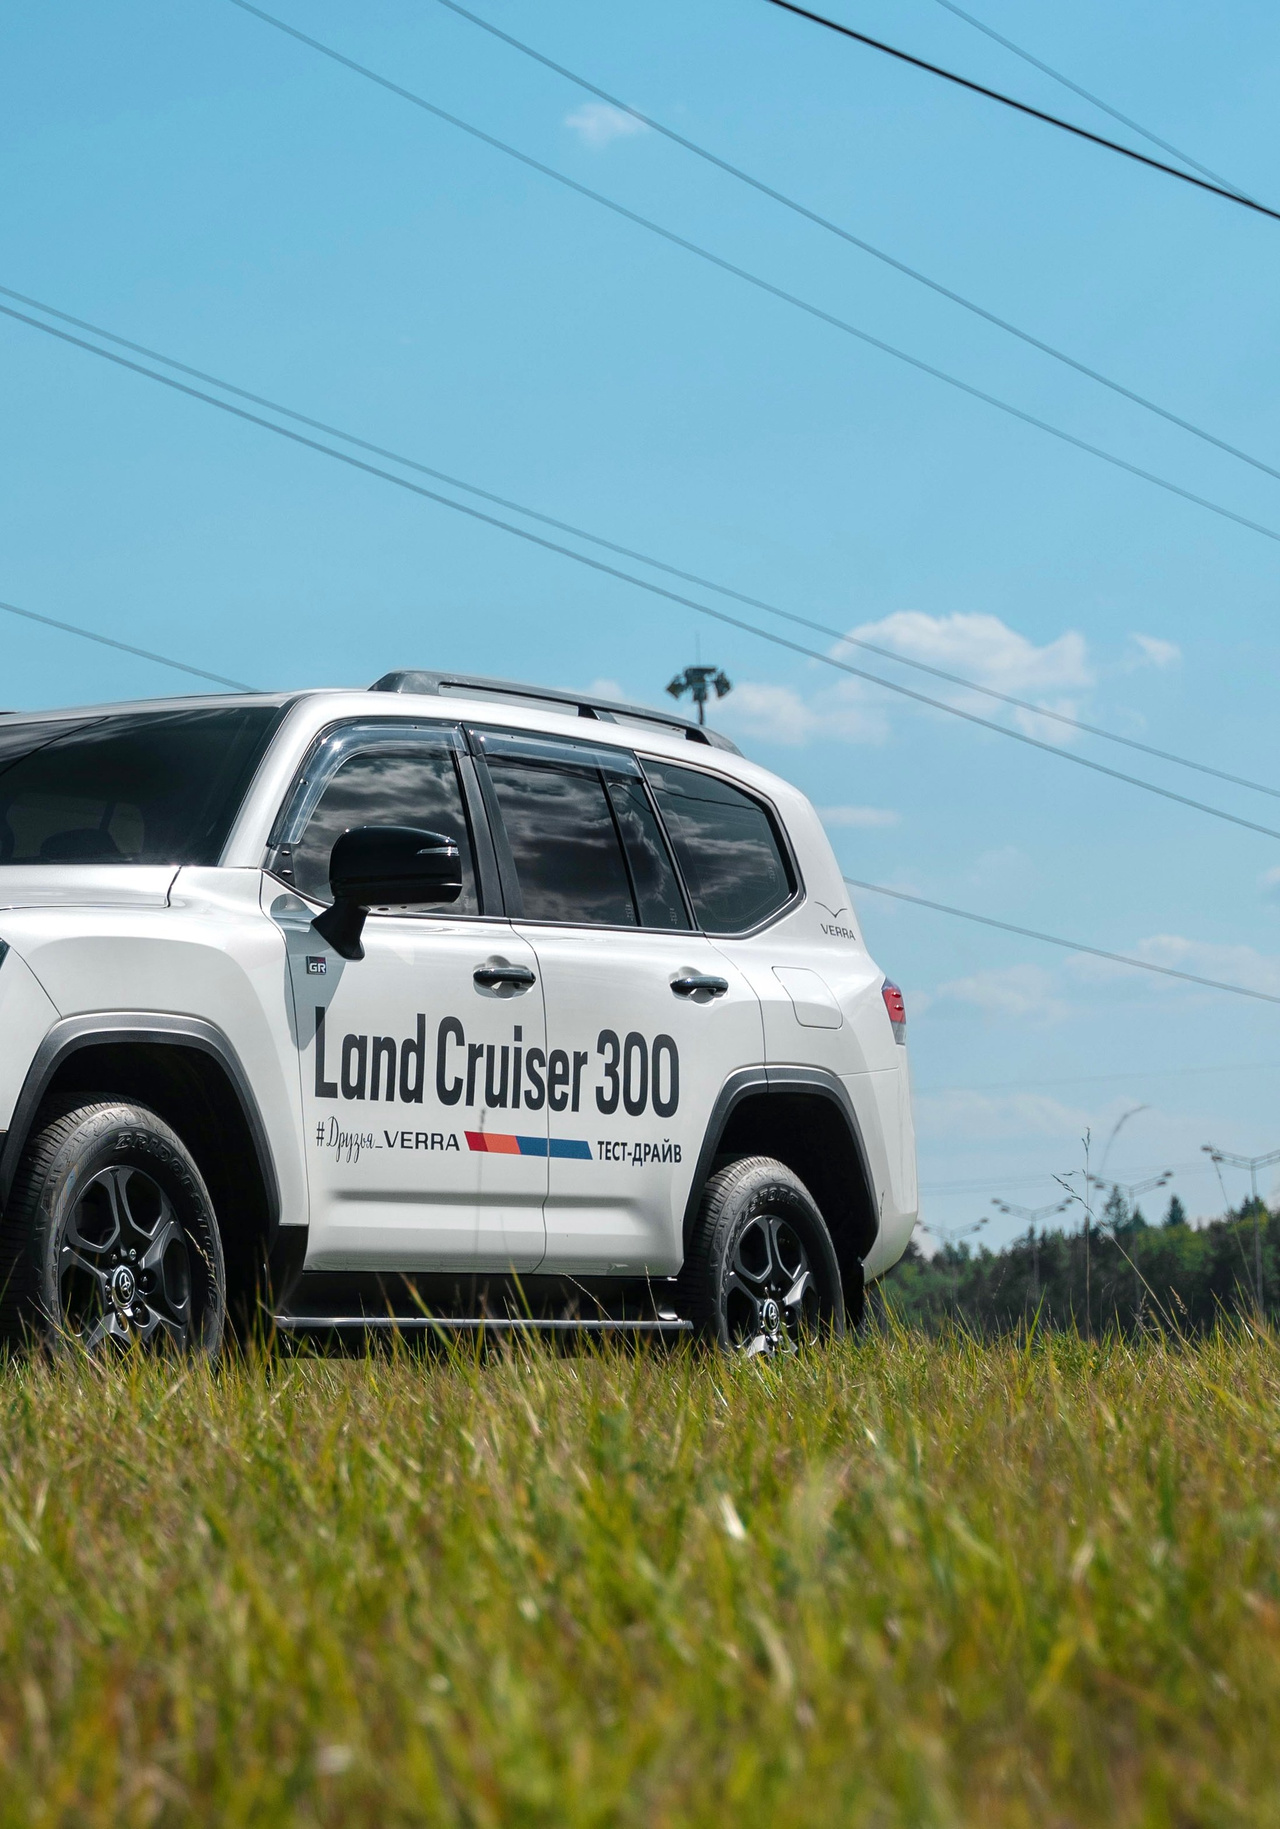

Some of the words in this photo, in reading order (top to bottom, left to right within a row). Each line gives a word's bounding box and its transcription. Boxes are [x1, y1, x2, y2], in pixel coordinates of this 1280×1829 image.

[820, 922, 856, 941] VERRA
[309, 962, 326, 973] GR
[314, 1006, 426, 1104] Land
[436, 1015, 588, 1113] Cruiser
[595, 1028, 680, 1118] 300
[597, 1138, 683, 1167] ТЕСТ-ДРАЙВ
